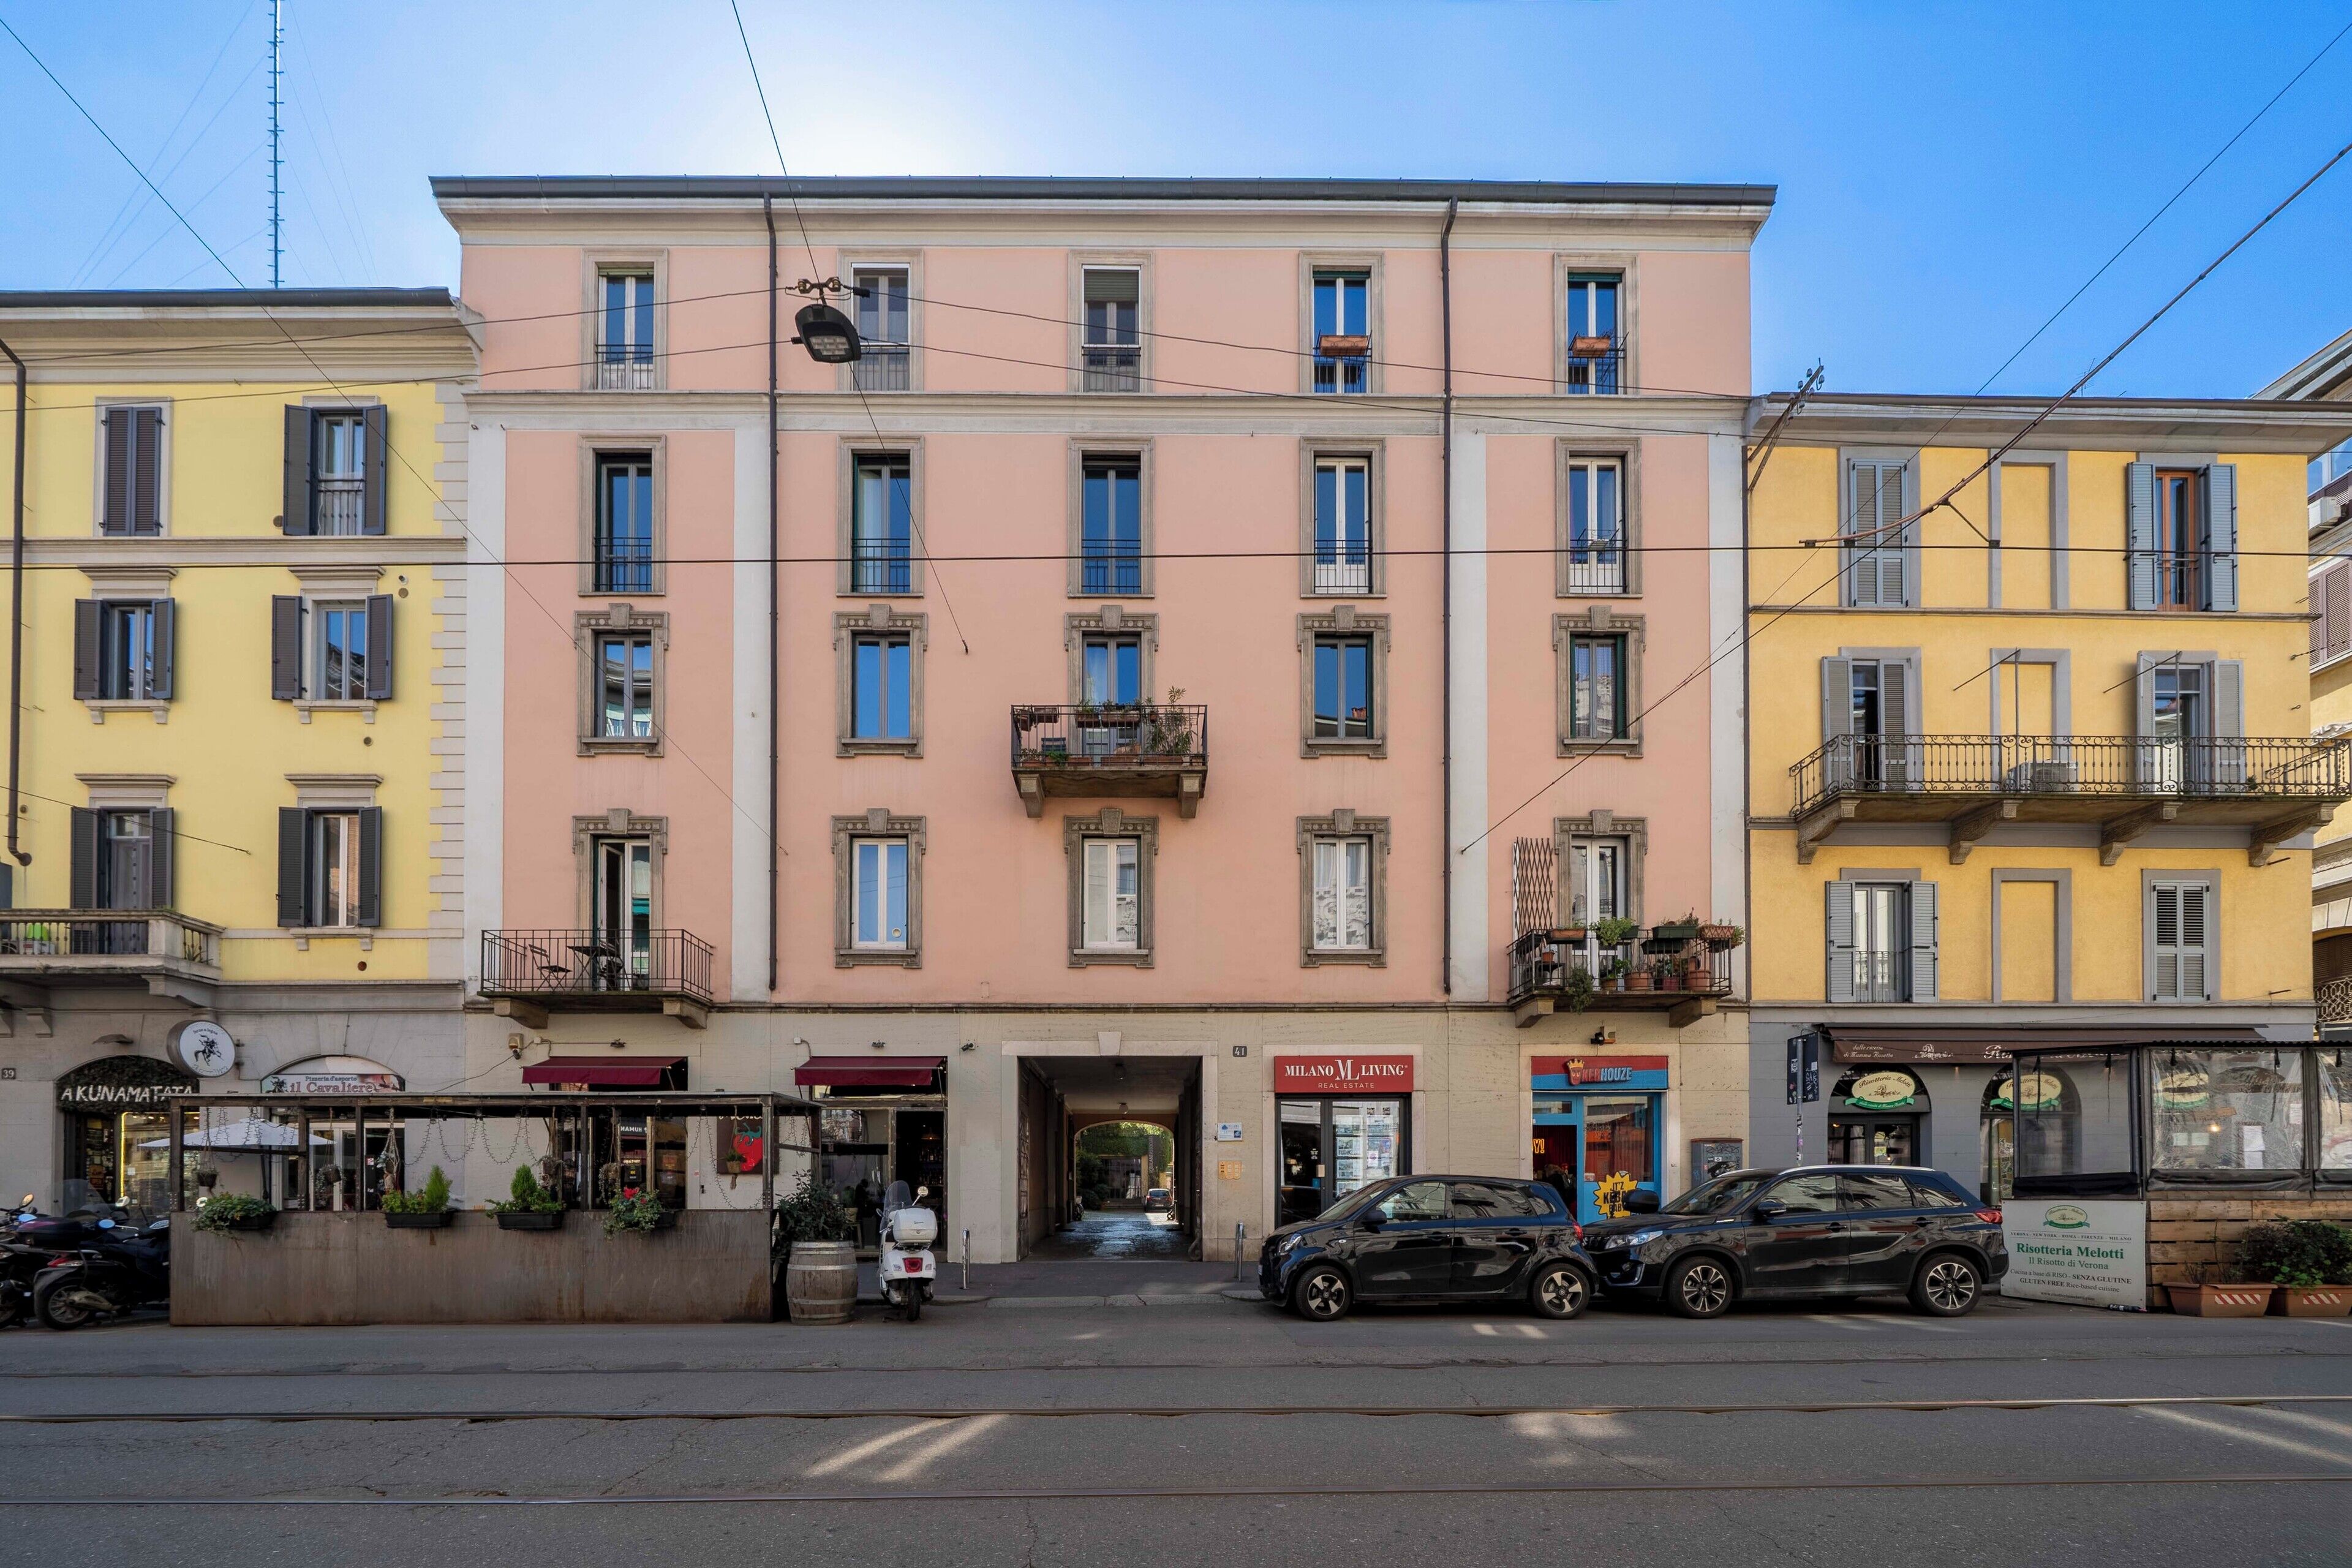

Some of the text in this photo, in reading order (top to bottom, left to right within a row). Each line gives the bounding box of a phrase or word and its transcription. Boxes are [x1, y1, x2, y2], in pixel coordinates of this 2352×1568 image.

[1235, 1047, 1245, 1055] 41
[3, 1069, 15, 1078] 39
[1284, 1065, 1334, 1076] MILANO
[290, 1081, 373, 1093] il Cavaliere
[1858, 1075, 1912, 1088] Risotteria Melotti
[2016, 1243, 2124, 1259] Risotteria Melotti
[2037, 1258, 2065, 1267] Risotto
[2079, 1260, 2108, 1270] Verona
[2097, 1276, 2132, 1284] GLUTINE
[2066, 1281, 2097, 1291] Rice-based
